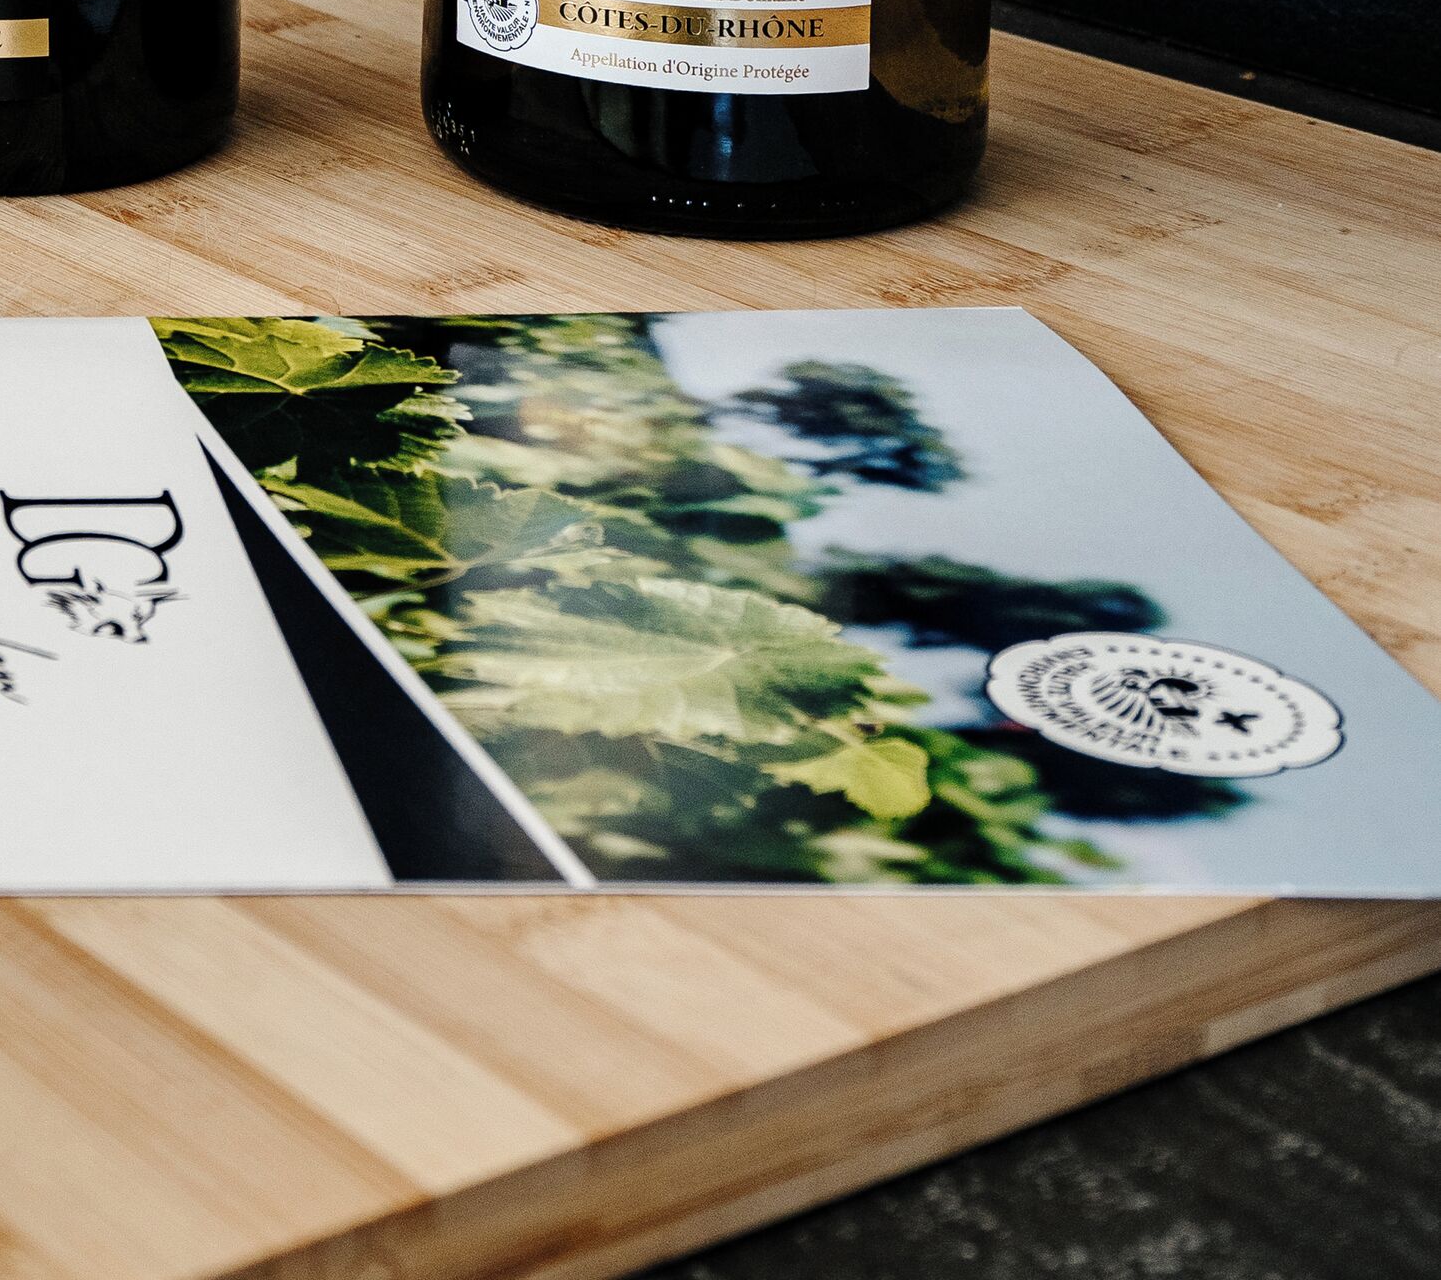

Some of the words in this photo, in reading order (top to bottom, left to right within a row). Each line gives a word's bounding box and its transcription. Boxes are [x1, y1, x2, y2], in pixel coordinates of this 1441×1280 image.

[472, 0, 530, 42] ENVIRONNEMENTALE
[478, 5, 496, 31] HAUTE
[496, 17, 521, 34] VALEUR
[558, 1, 824, 39] CÔTES-DU-RHÔNE
[570, 47, 658, 72] Appellation
[662, 58, 739, 82] d'Origine
[742, 64, 810, 83] Protégée
